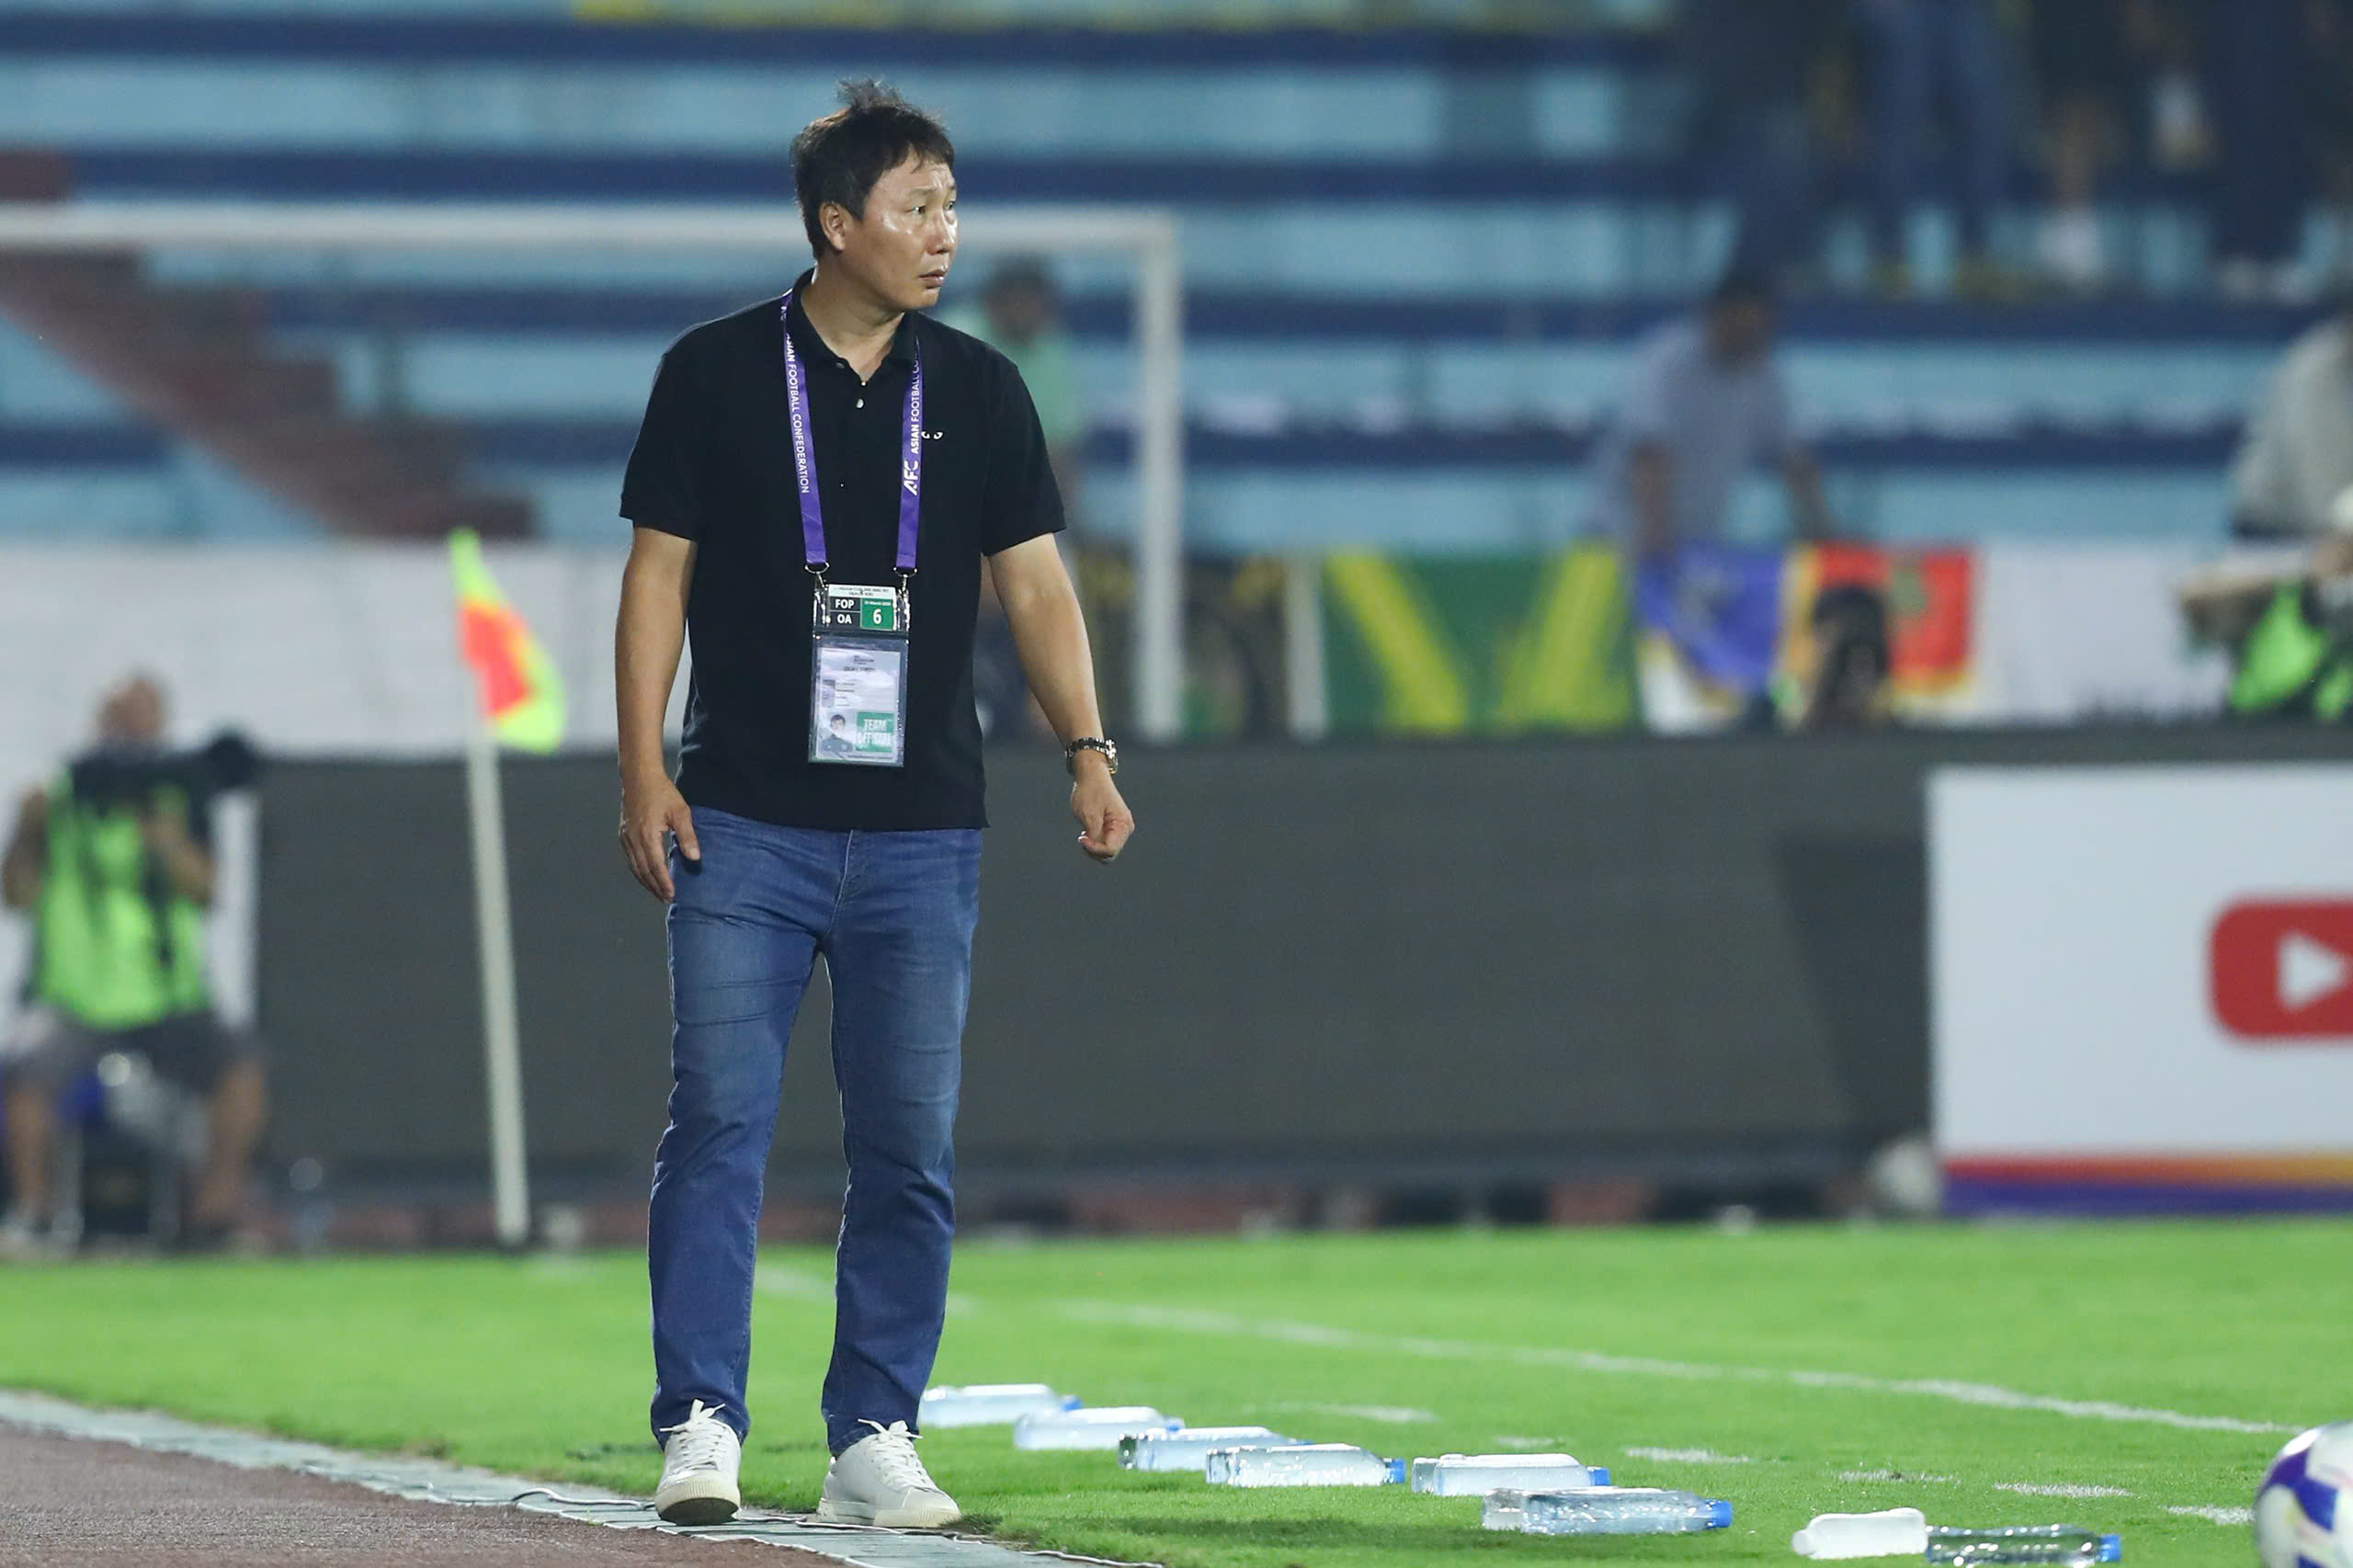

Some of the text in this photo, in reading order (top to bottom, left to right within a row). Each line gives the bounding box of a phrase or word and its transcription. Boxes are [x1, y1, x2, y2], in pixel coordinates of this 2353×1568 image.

[788, 364, 801, 413] FOOTBALL
[792, 414, 810, 494] CONFEDERATION
[910, 424, 920, 455] ASIAN
[904, 460, 919, 496] AFC
[835, 598, 855, 609] FOP
[836, 613, 853, 624] OA
[872, 608, 882, 625] 6
